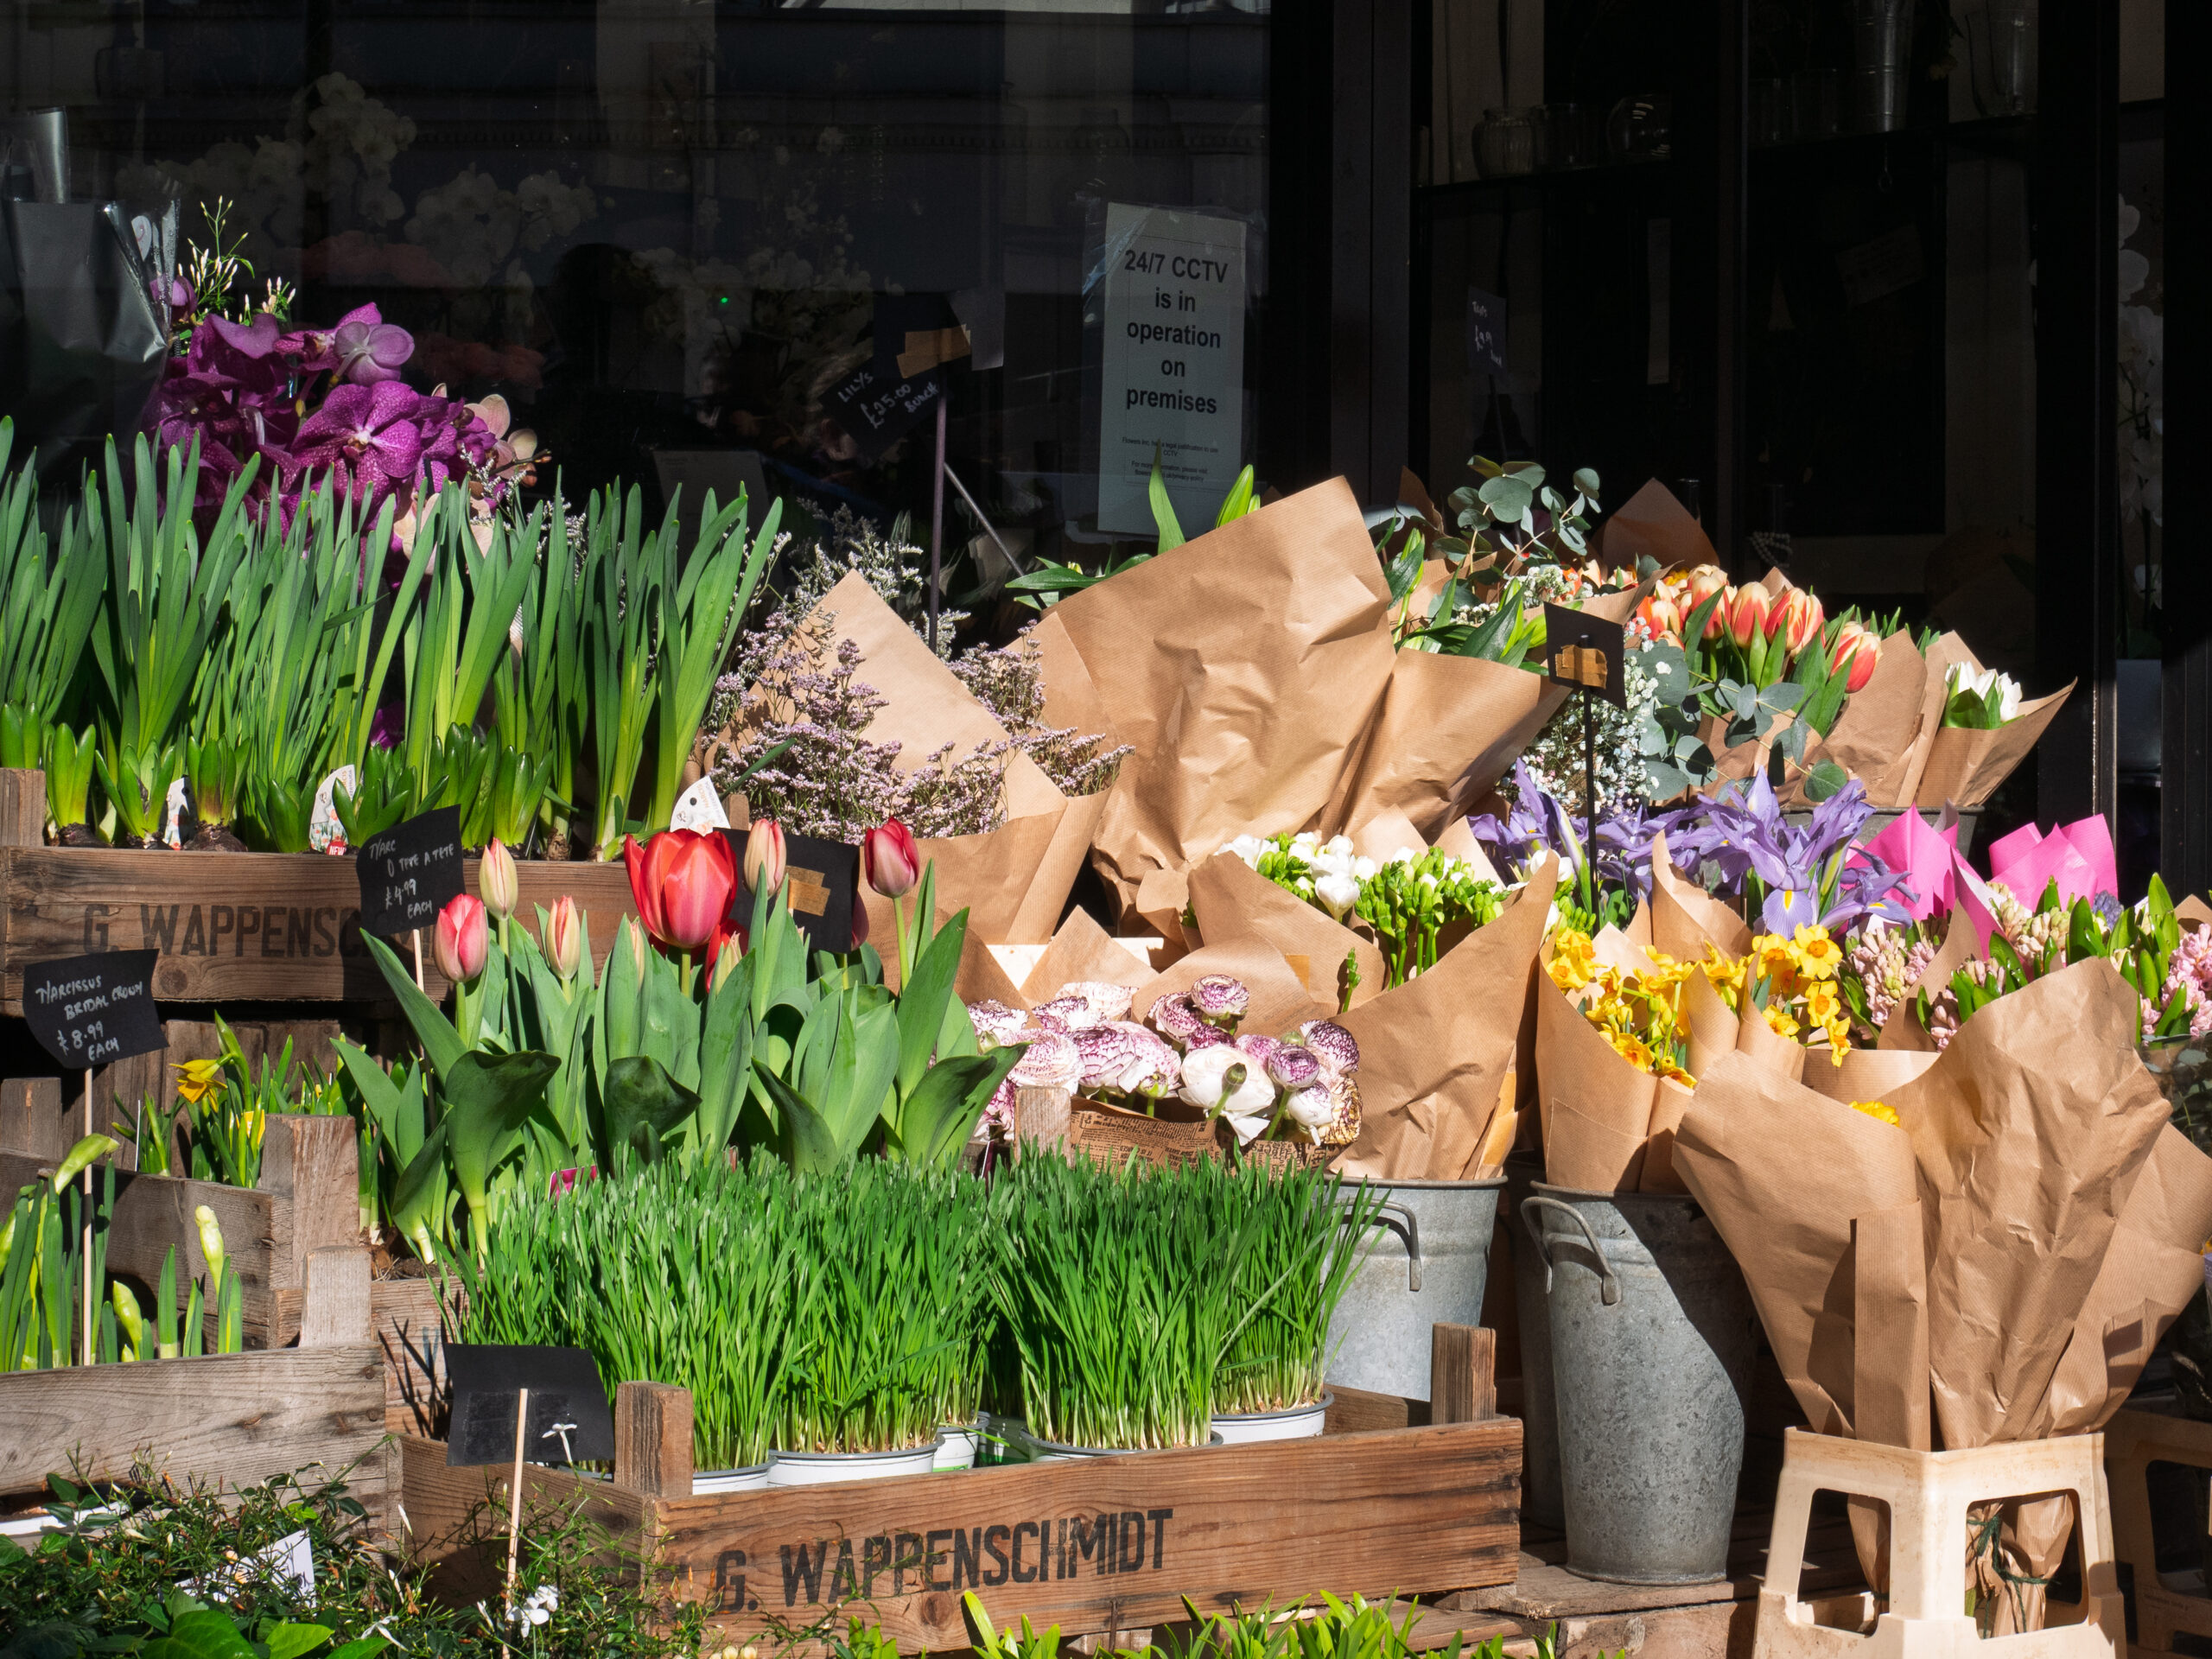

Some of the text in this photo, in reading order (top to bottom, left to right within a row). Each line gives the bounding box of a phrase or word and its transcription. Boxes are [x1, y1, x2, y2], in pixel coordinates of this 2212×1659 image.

[1124, 249, 1229, 283] 24/7 CCTV
[1155, 287, 1196, 312] is in
[1127, 321, 1221, 349] operation
[1161, 359, 1185, 378] on
[1126, 388, 1217, 415] premises
[423, 851, 431, 867] A
[385, 878, 416, 911] £4.99
[407, 899, 433, 919] EACH
[35, 975, 102, 1005] NARCISSUS
[64, 981, 143, 1021] BRIDAL CROWN
[57, 1020, 104, 1057] £8.99
[88, 1037, 120, 1062] EACH
[715, 1508, 1173, 1613] G. WAPPENSCHMIDT
